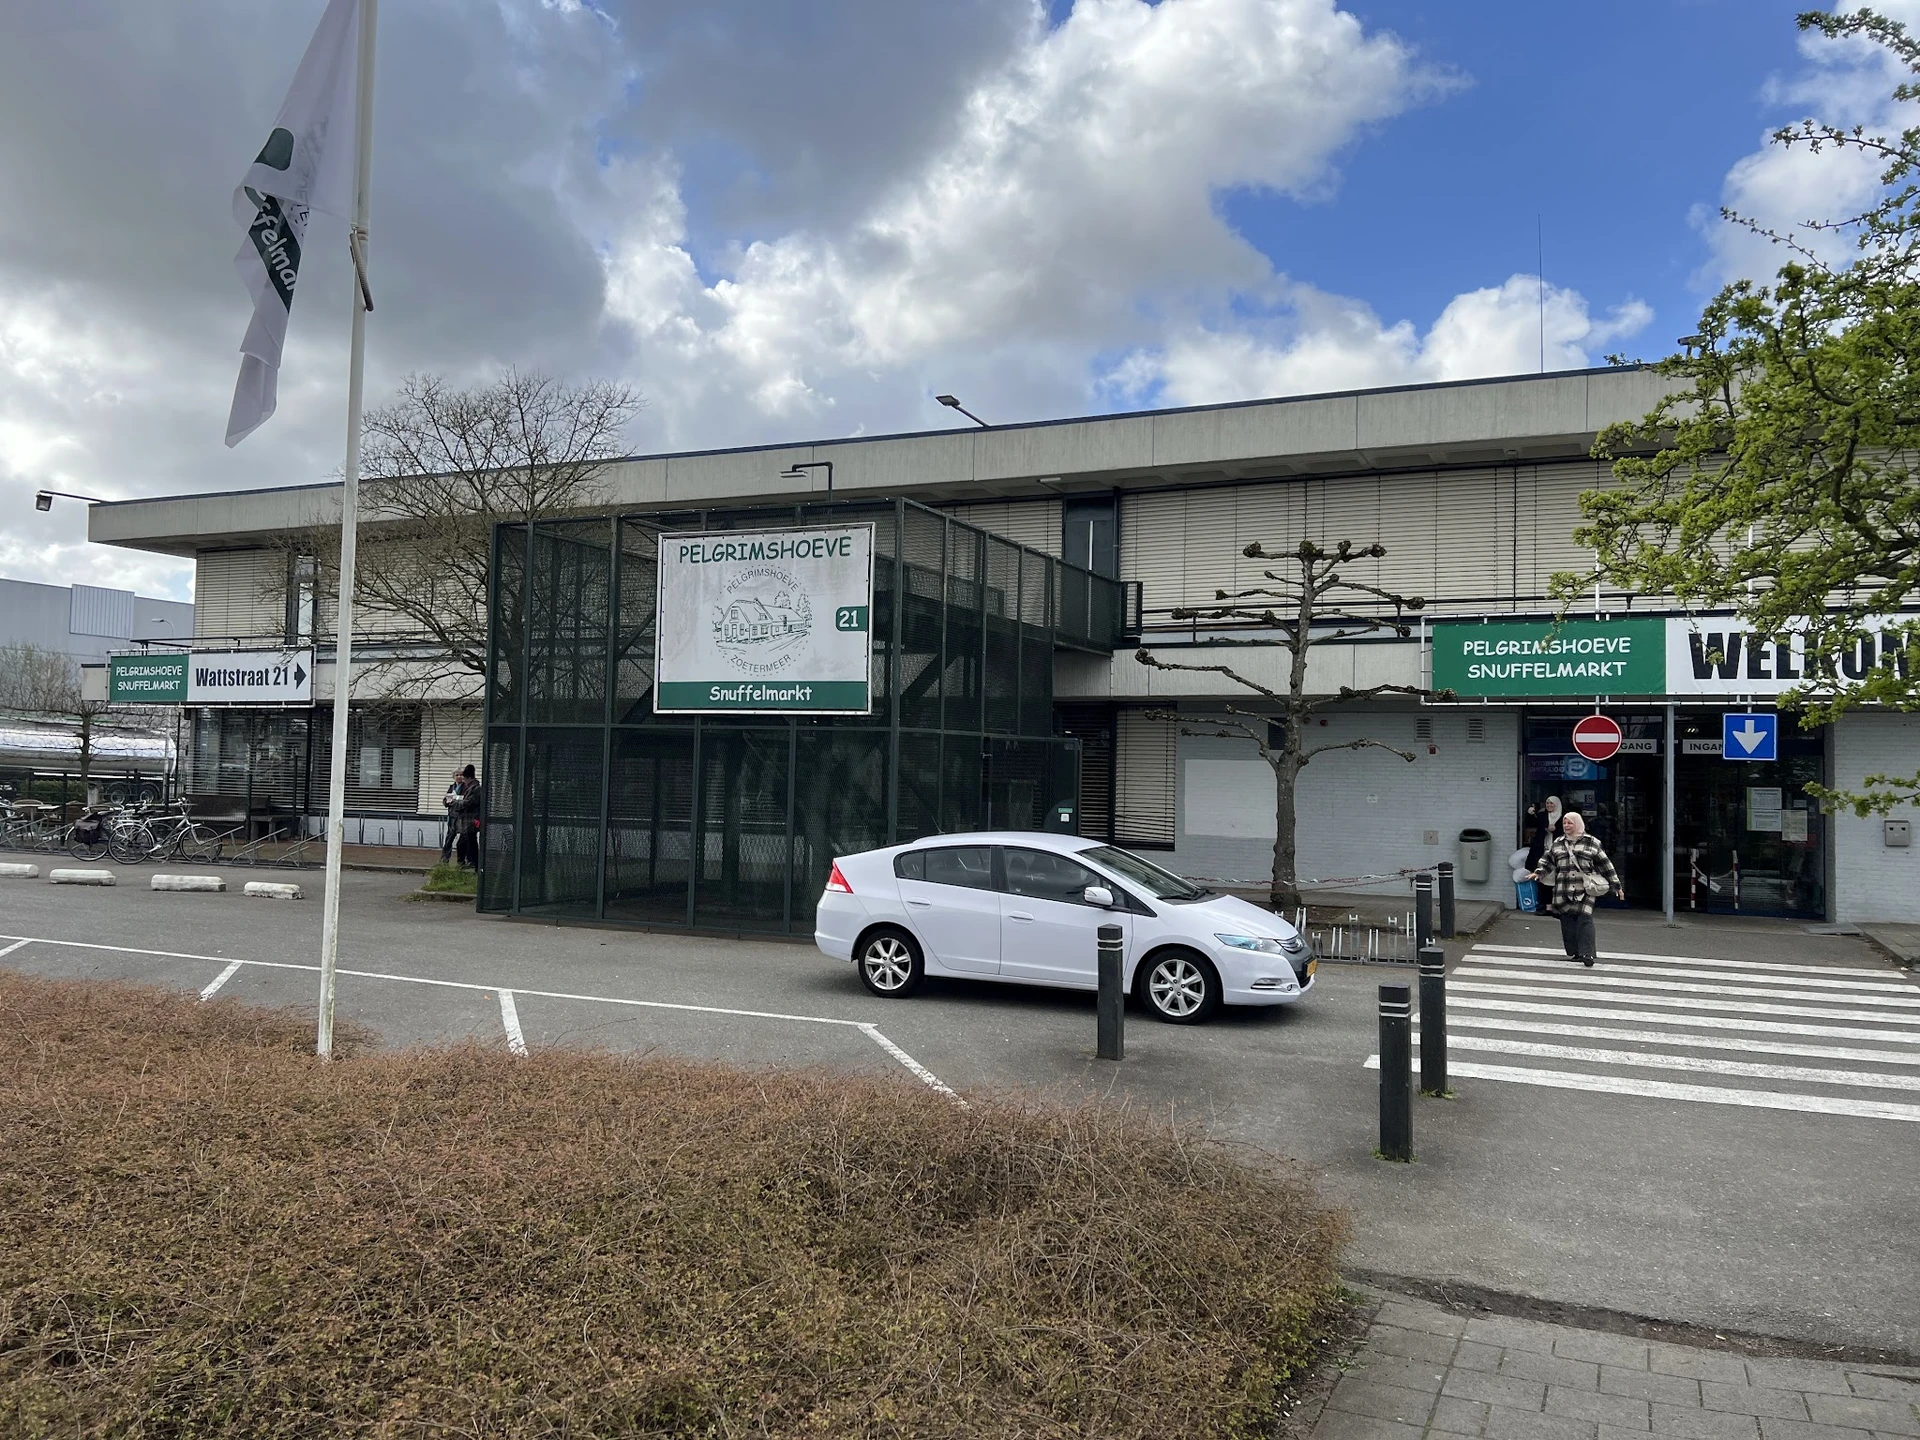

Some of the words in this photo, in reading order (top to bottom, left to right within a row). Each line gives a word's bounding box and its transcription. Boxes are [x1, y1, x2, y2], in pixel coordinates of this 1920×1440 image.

[679, 536, 852, 564] PELGRIMSHOEVE
[726, 568, 799, 595] PELGRIMSHOEVE
[838, 610, 859, 628] 21
[115, 665, 183, 677] PELGRIMSHOEVE
[730, 654, 792, 673] ZOETERMEER
[1467, 661, 1627, 679] SNUFFELMARKT
[117, 680, 181, 691] SNUFFELMARKT
[196, 667, 269, 687] Wattstraat
[273, 666, 288, 686] 21
[709, 684, 812, 702] Snuffelmarkt
[1620, 742, 1652, 751] GANG
[1689, 742, 1724, 751] INGAN
